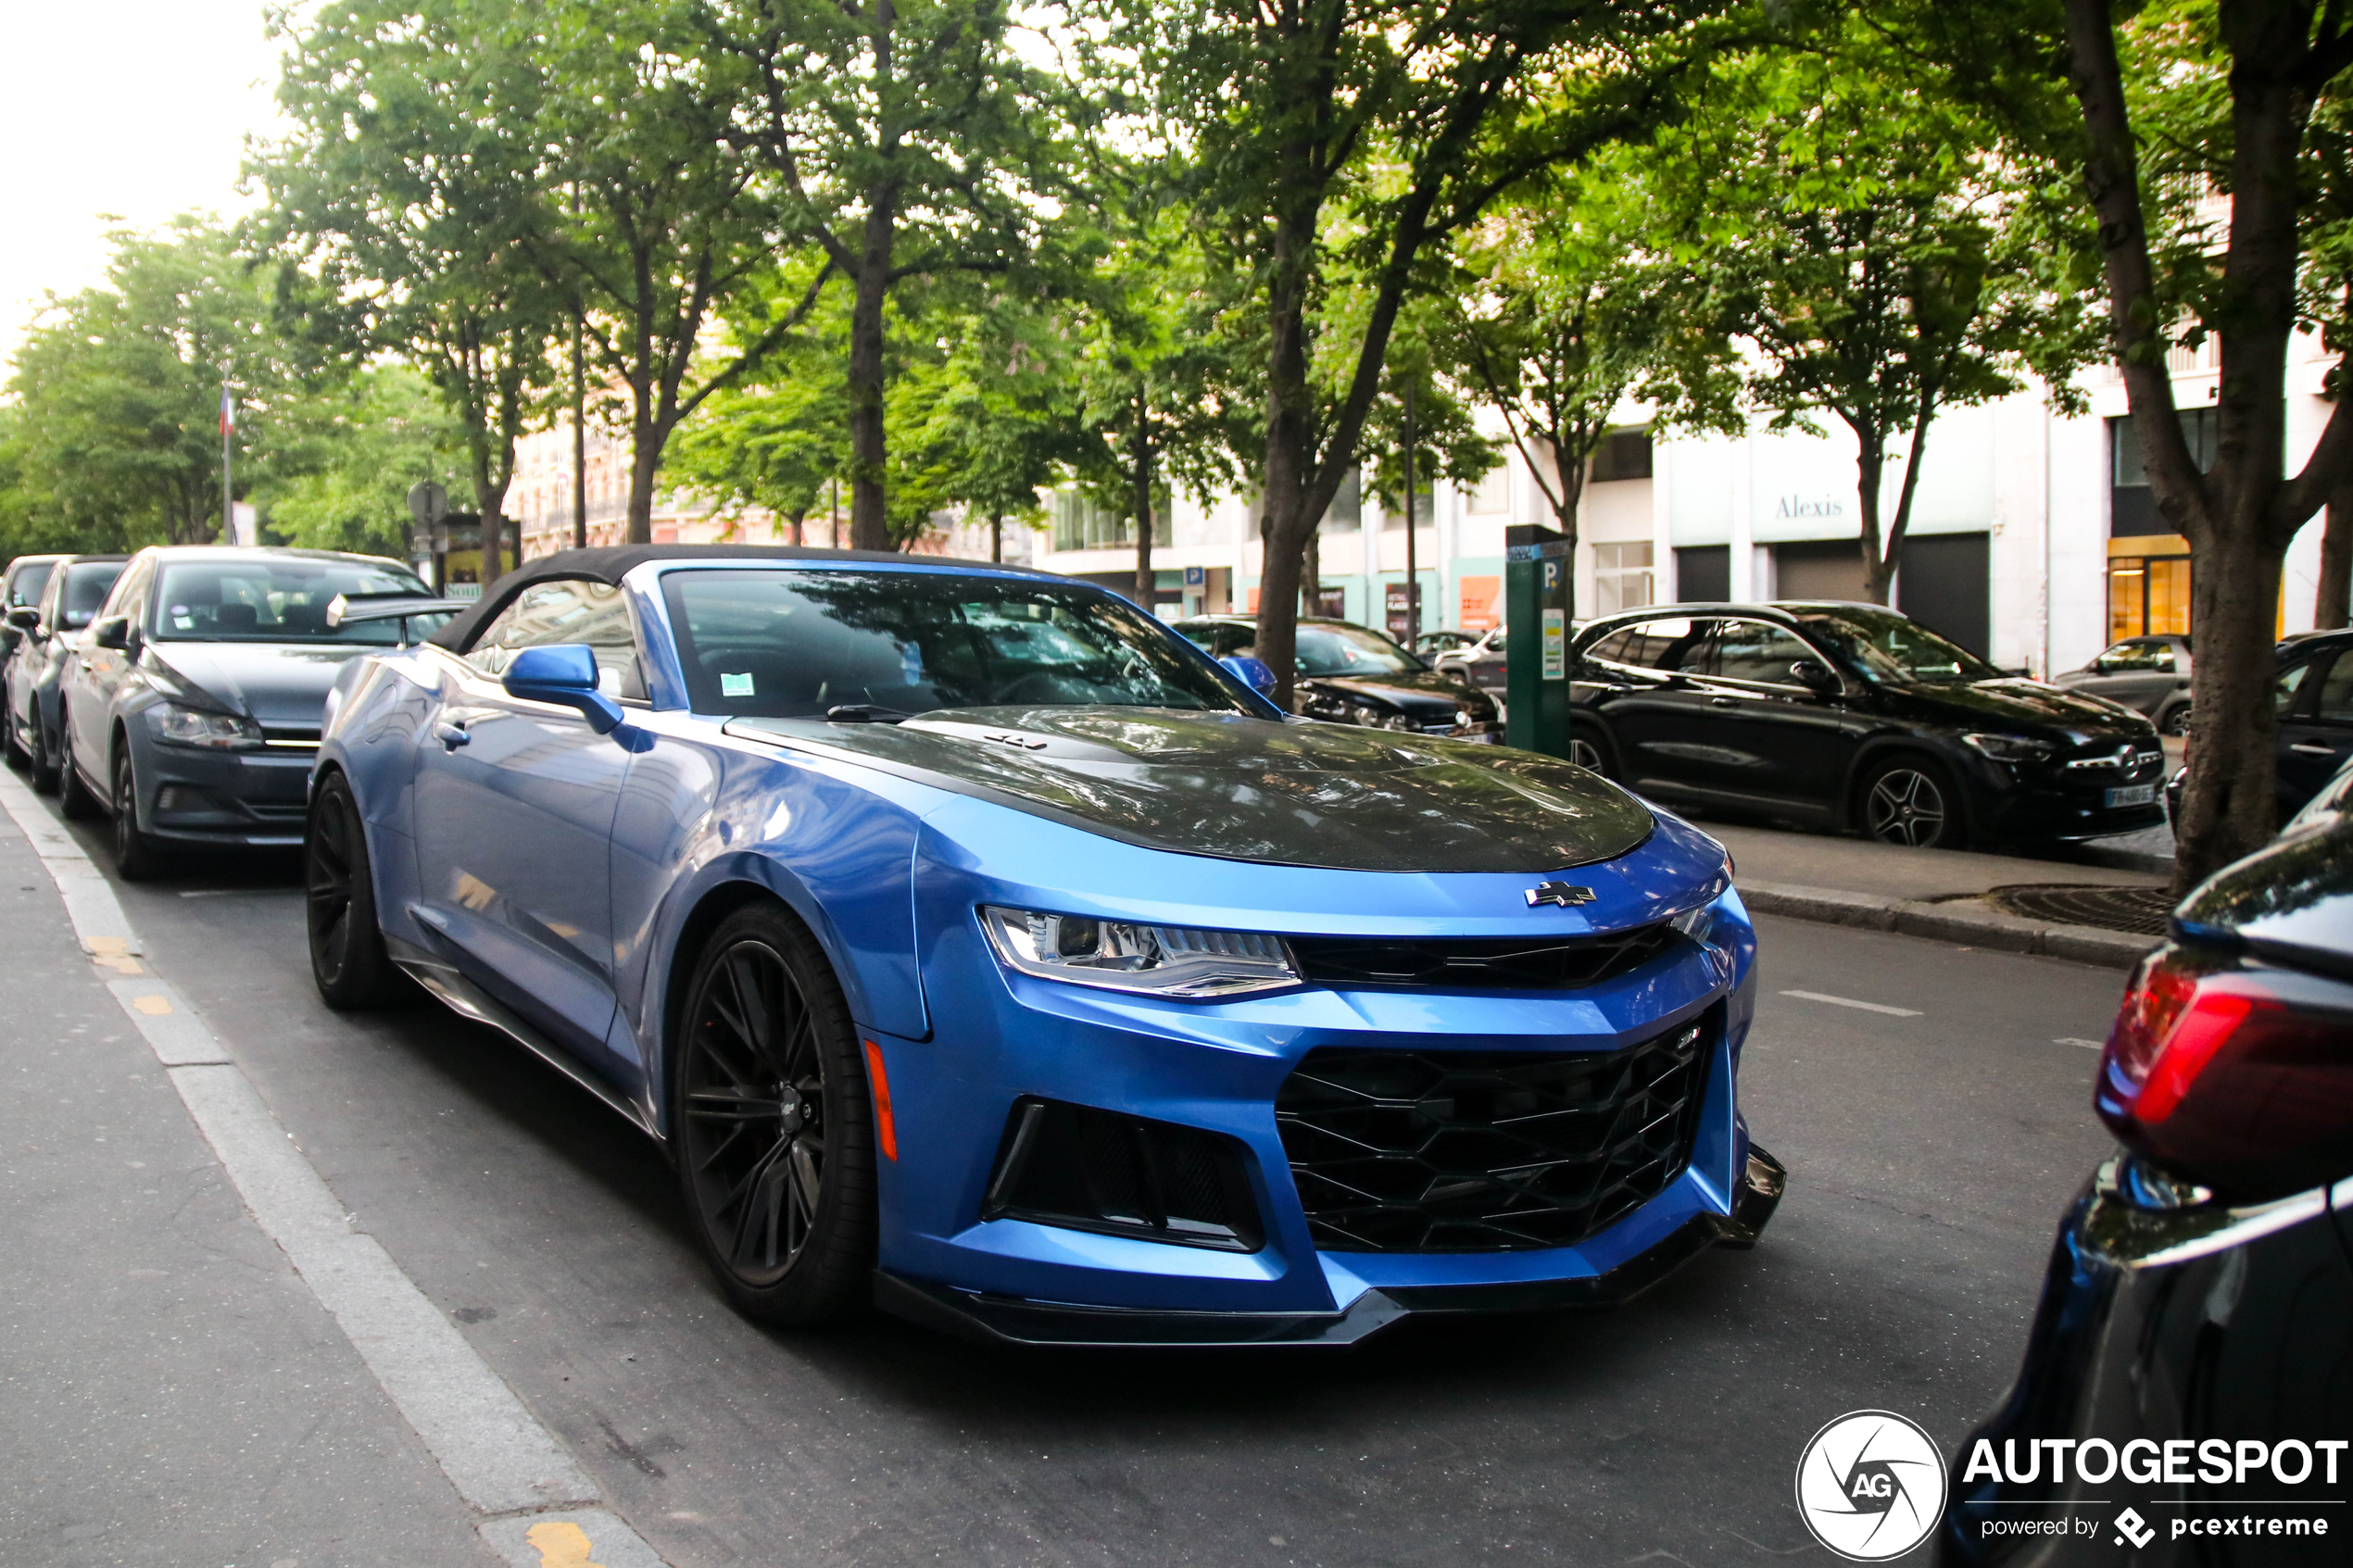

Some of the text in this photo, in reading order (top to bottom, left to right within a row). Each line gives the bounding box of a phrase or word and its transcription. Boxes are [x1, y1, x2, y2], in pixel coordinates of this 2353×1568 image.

[1776, 494, 1843, 520] Alexis
[1189, 569, 1200, 582] P
[1544, 562, 1556, 588] P
